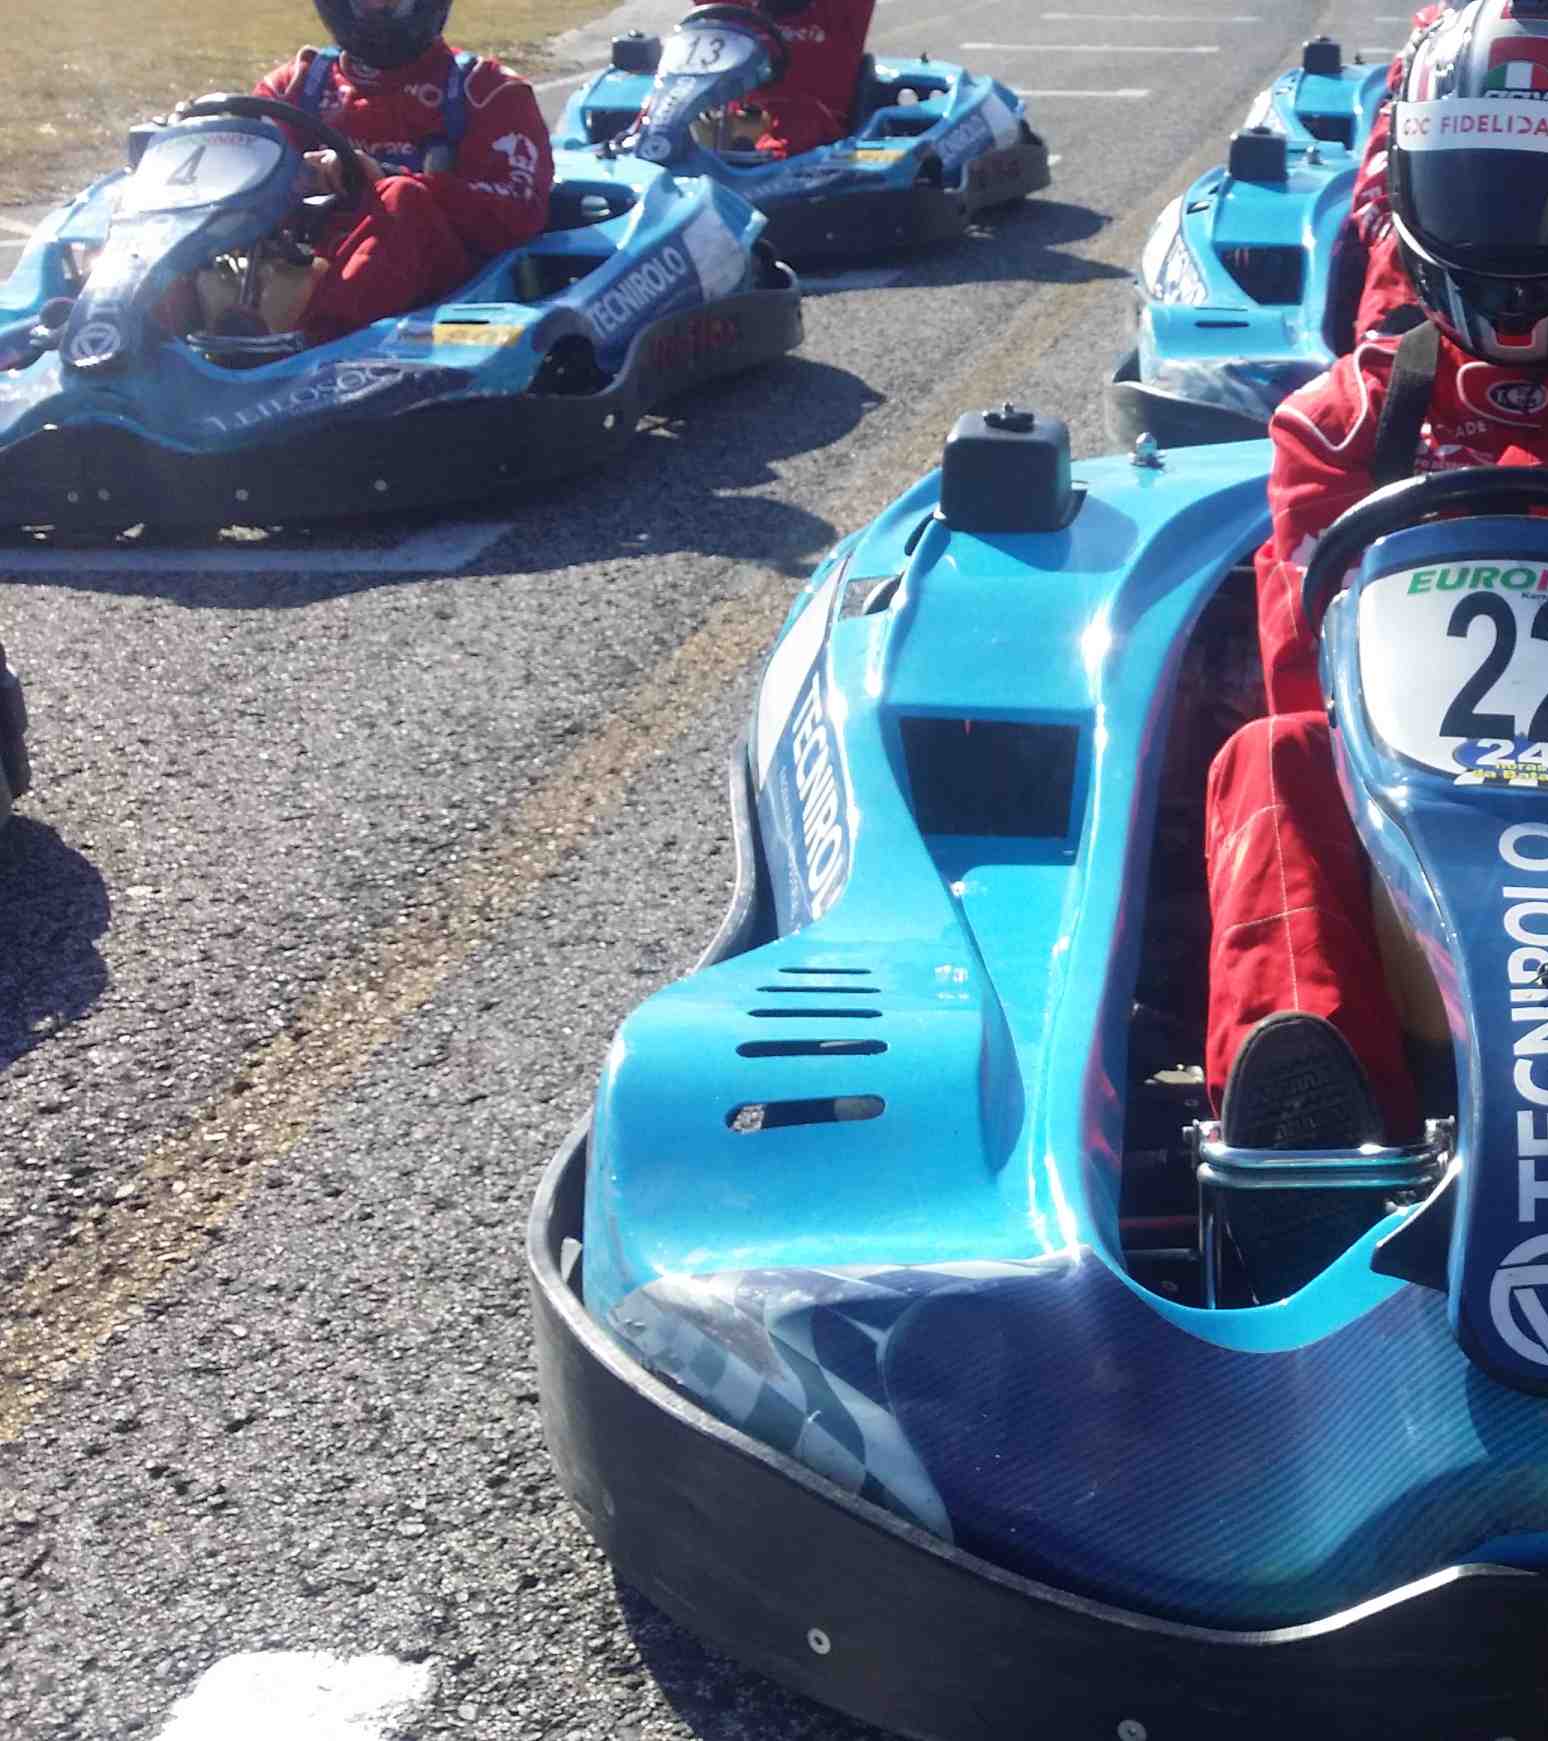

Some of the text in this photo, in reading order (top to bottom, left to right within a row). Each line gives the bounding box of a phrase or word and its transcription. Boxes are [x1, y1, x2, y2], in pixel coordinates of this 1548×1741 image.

[684, 36, 725, 66] 13
[165, 144, 208, 187] 4
[591, 246, 688, 339] TECNIROLO
[793, 672, 845, 921] TECNIROL
